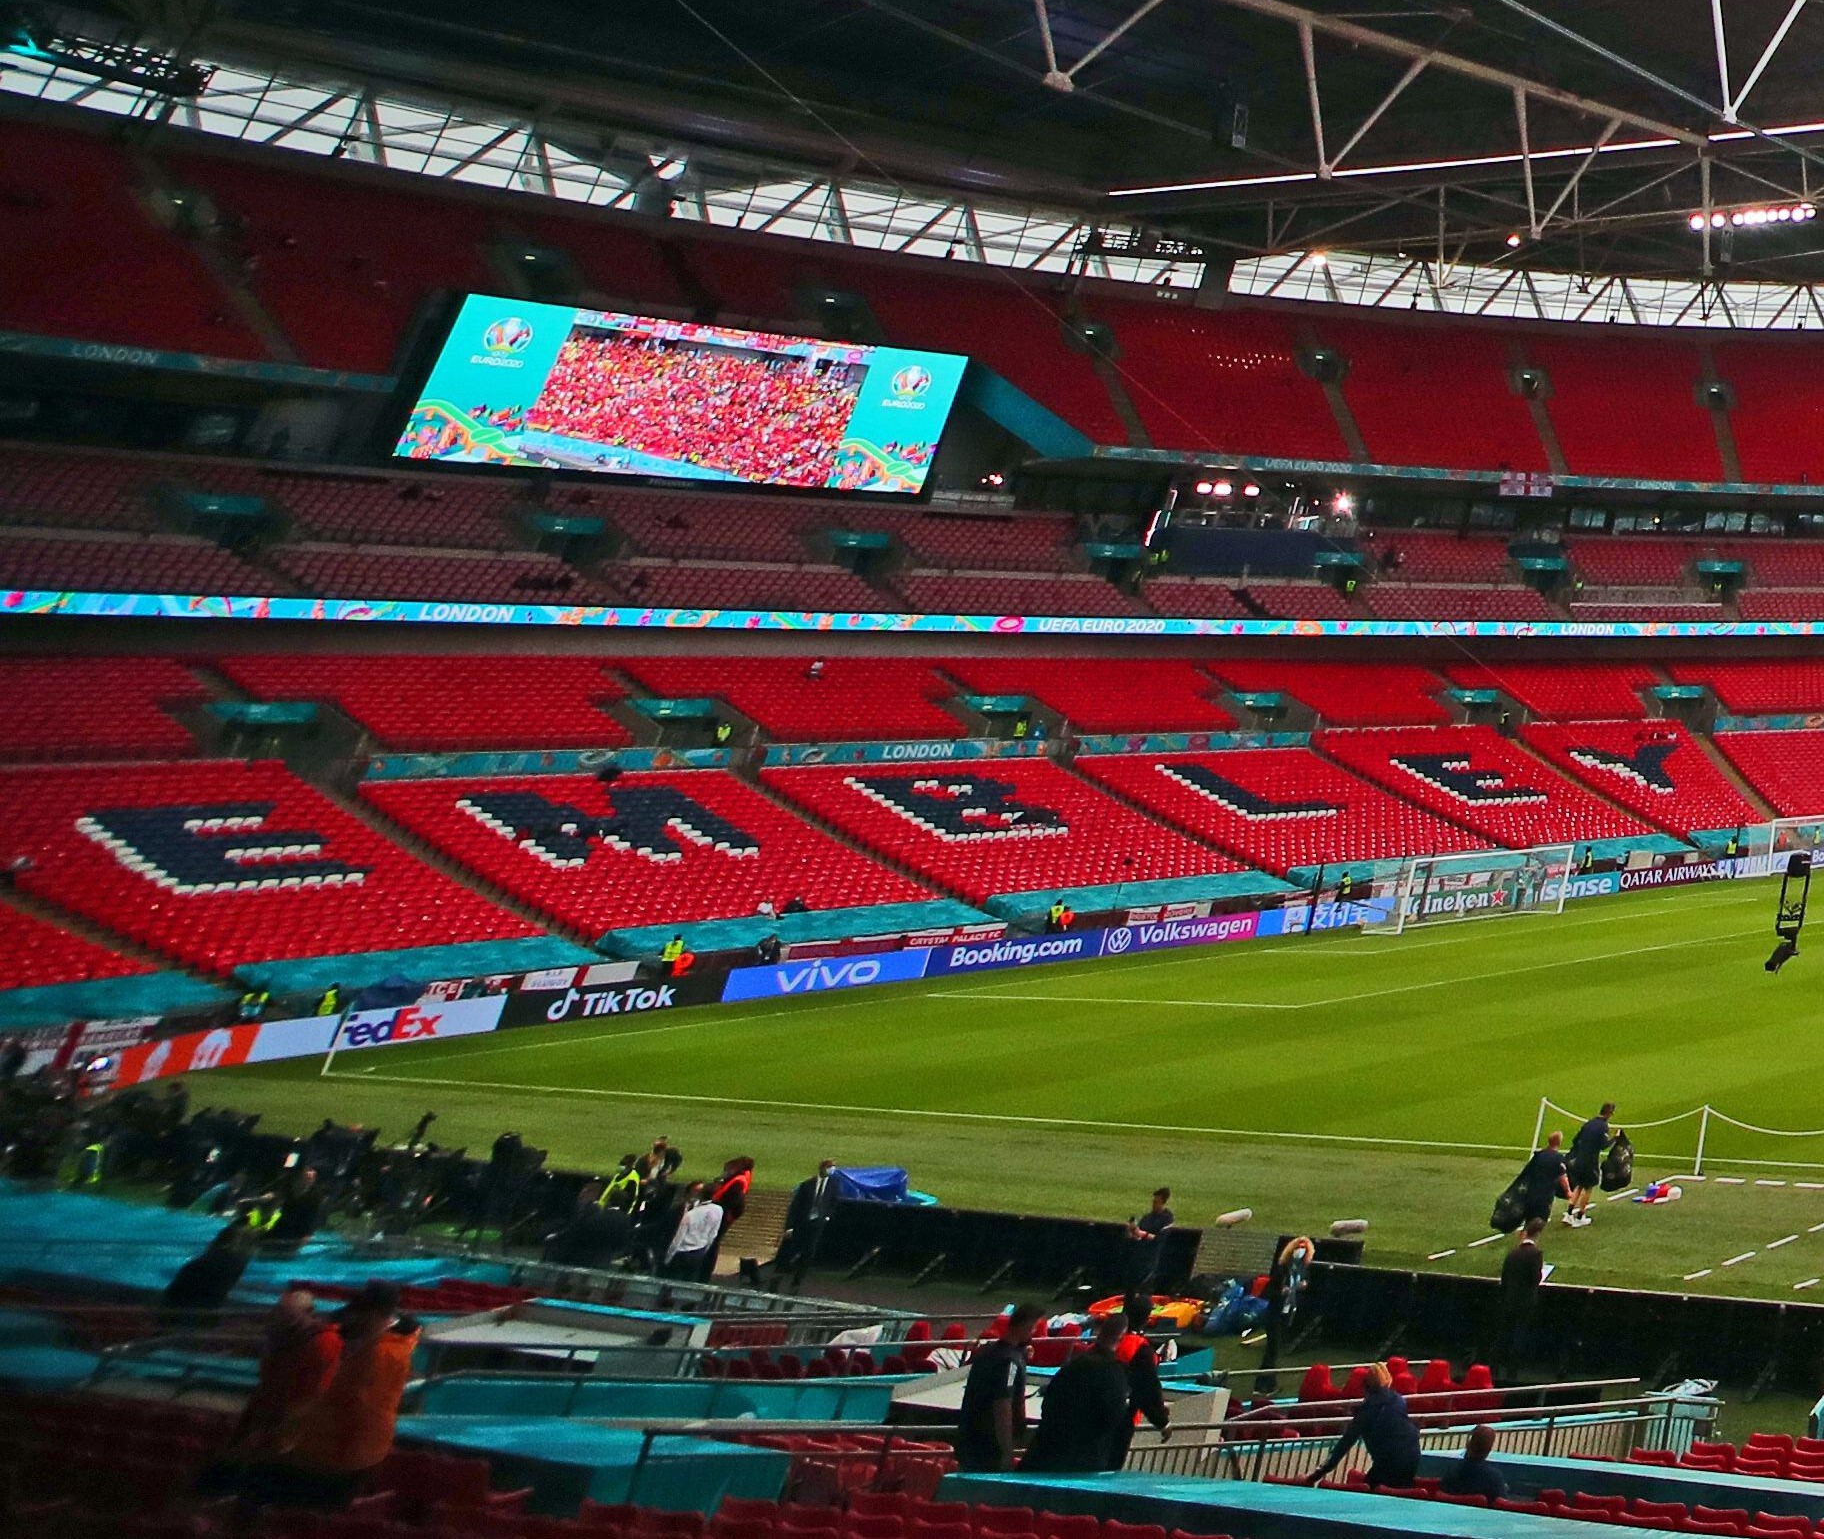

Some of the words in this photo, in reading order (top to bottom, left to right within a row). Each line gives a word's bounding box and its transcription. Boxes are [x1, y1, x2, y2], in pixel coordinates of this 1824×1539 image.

[1635, 480, 1676, 491] LONDON
[419, 602, 516, 624] LONDON
[1039, 619, 1081, 632] UEFA
[1082, 619, 1124, 633] EURO
[1125, 619, 1166, 634] 2020
[1561, 623, 1614, 637] LONDON
[881, 742, 954, 759] LONDON
[1619, 870, 1662, 889] QATAR
[1665, 862, 1719, 882] AIRWAYS
[952, 931, 988, 944] PALACE
[1139, 915, 1252, 947] Volkswagen
[950, 935, 1083, 967] Booking.com
[776, 958, 881, 994] vivo
[582, 984, 677, 1017] TikTok
